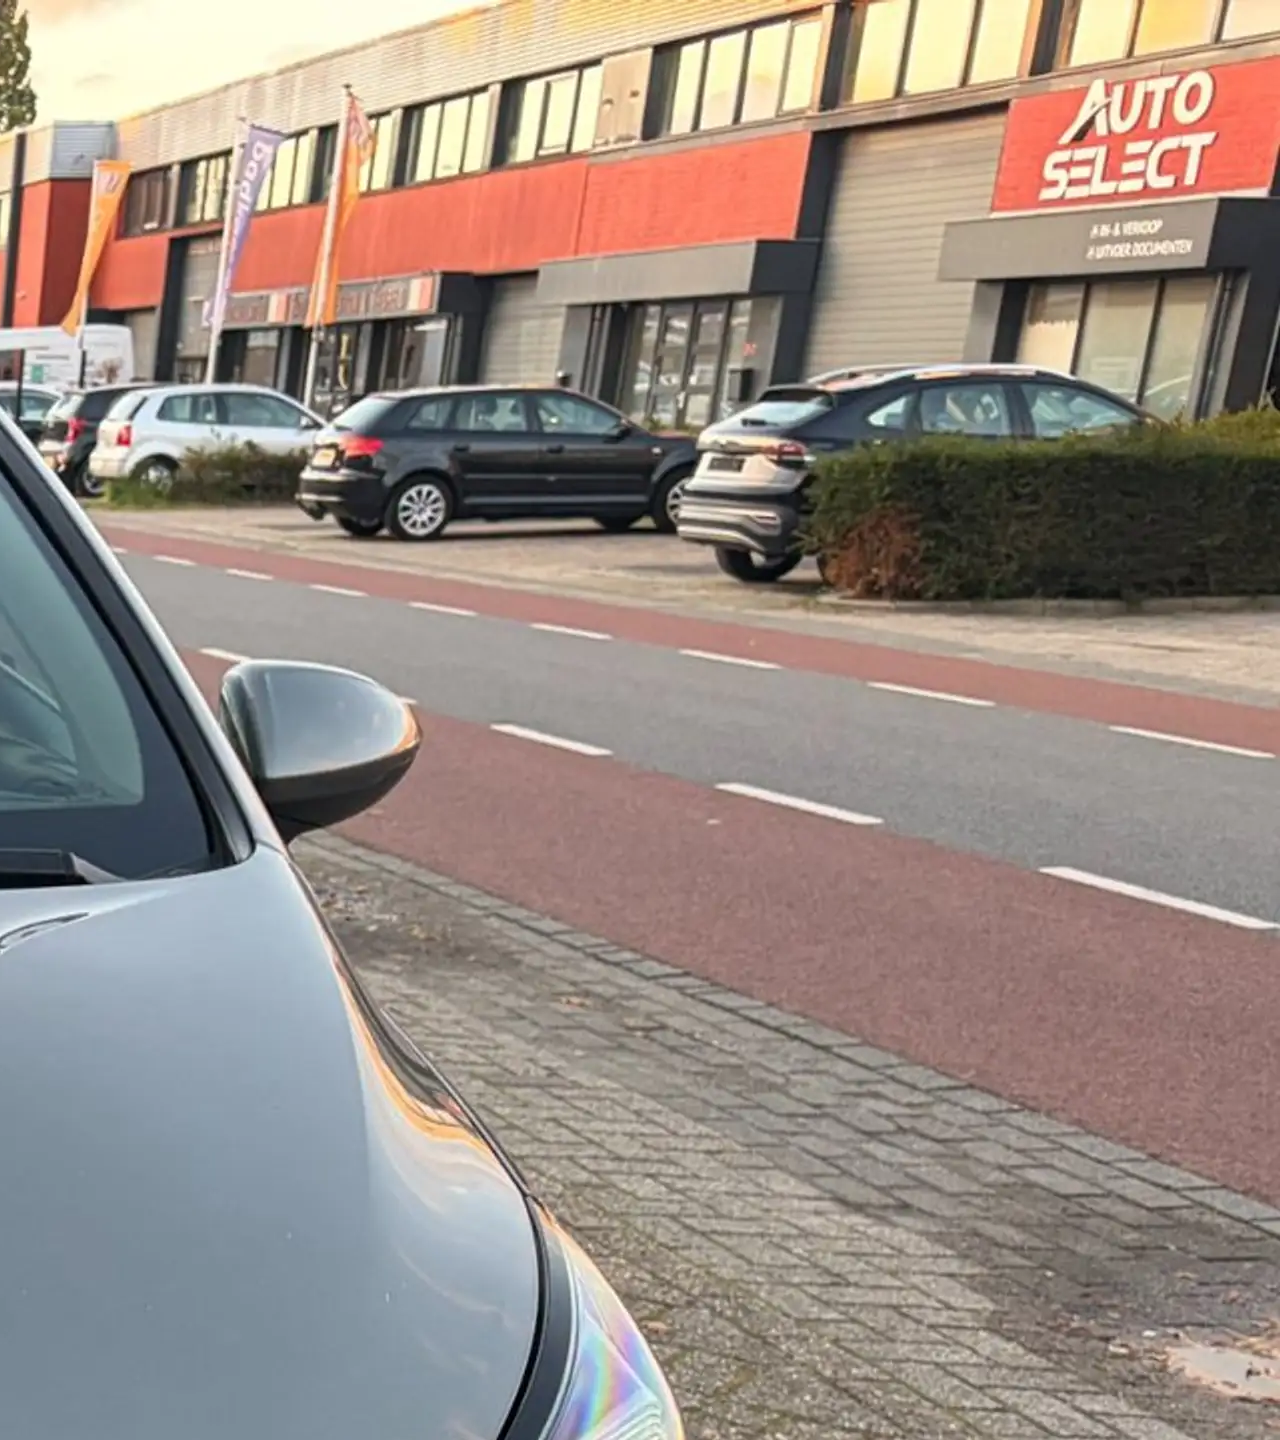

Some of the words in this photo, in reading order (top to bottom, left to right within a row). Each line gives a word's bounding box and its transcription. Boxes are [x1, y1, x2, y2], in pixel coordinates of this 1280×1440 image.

[1058, 71, 1214, 144] AUTO
[1038, 131, 1219, 200] SELECT
[1132, 239, 1193, 257] DOCUMENTEN
